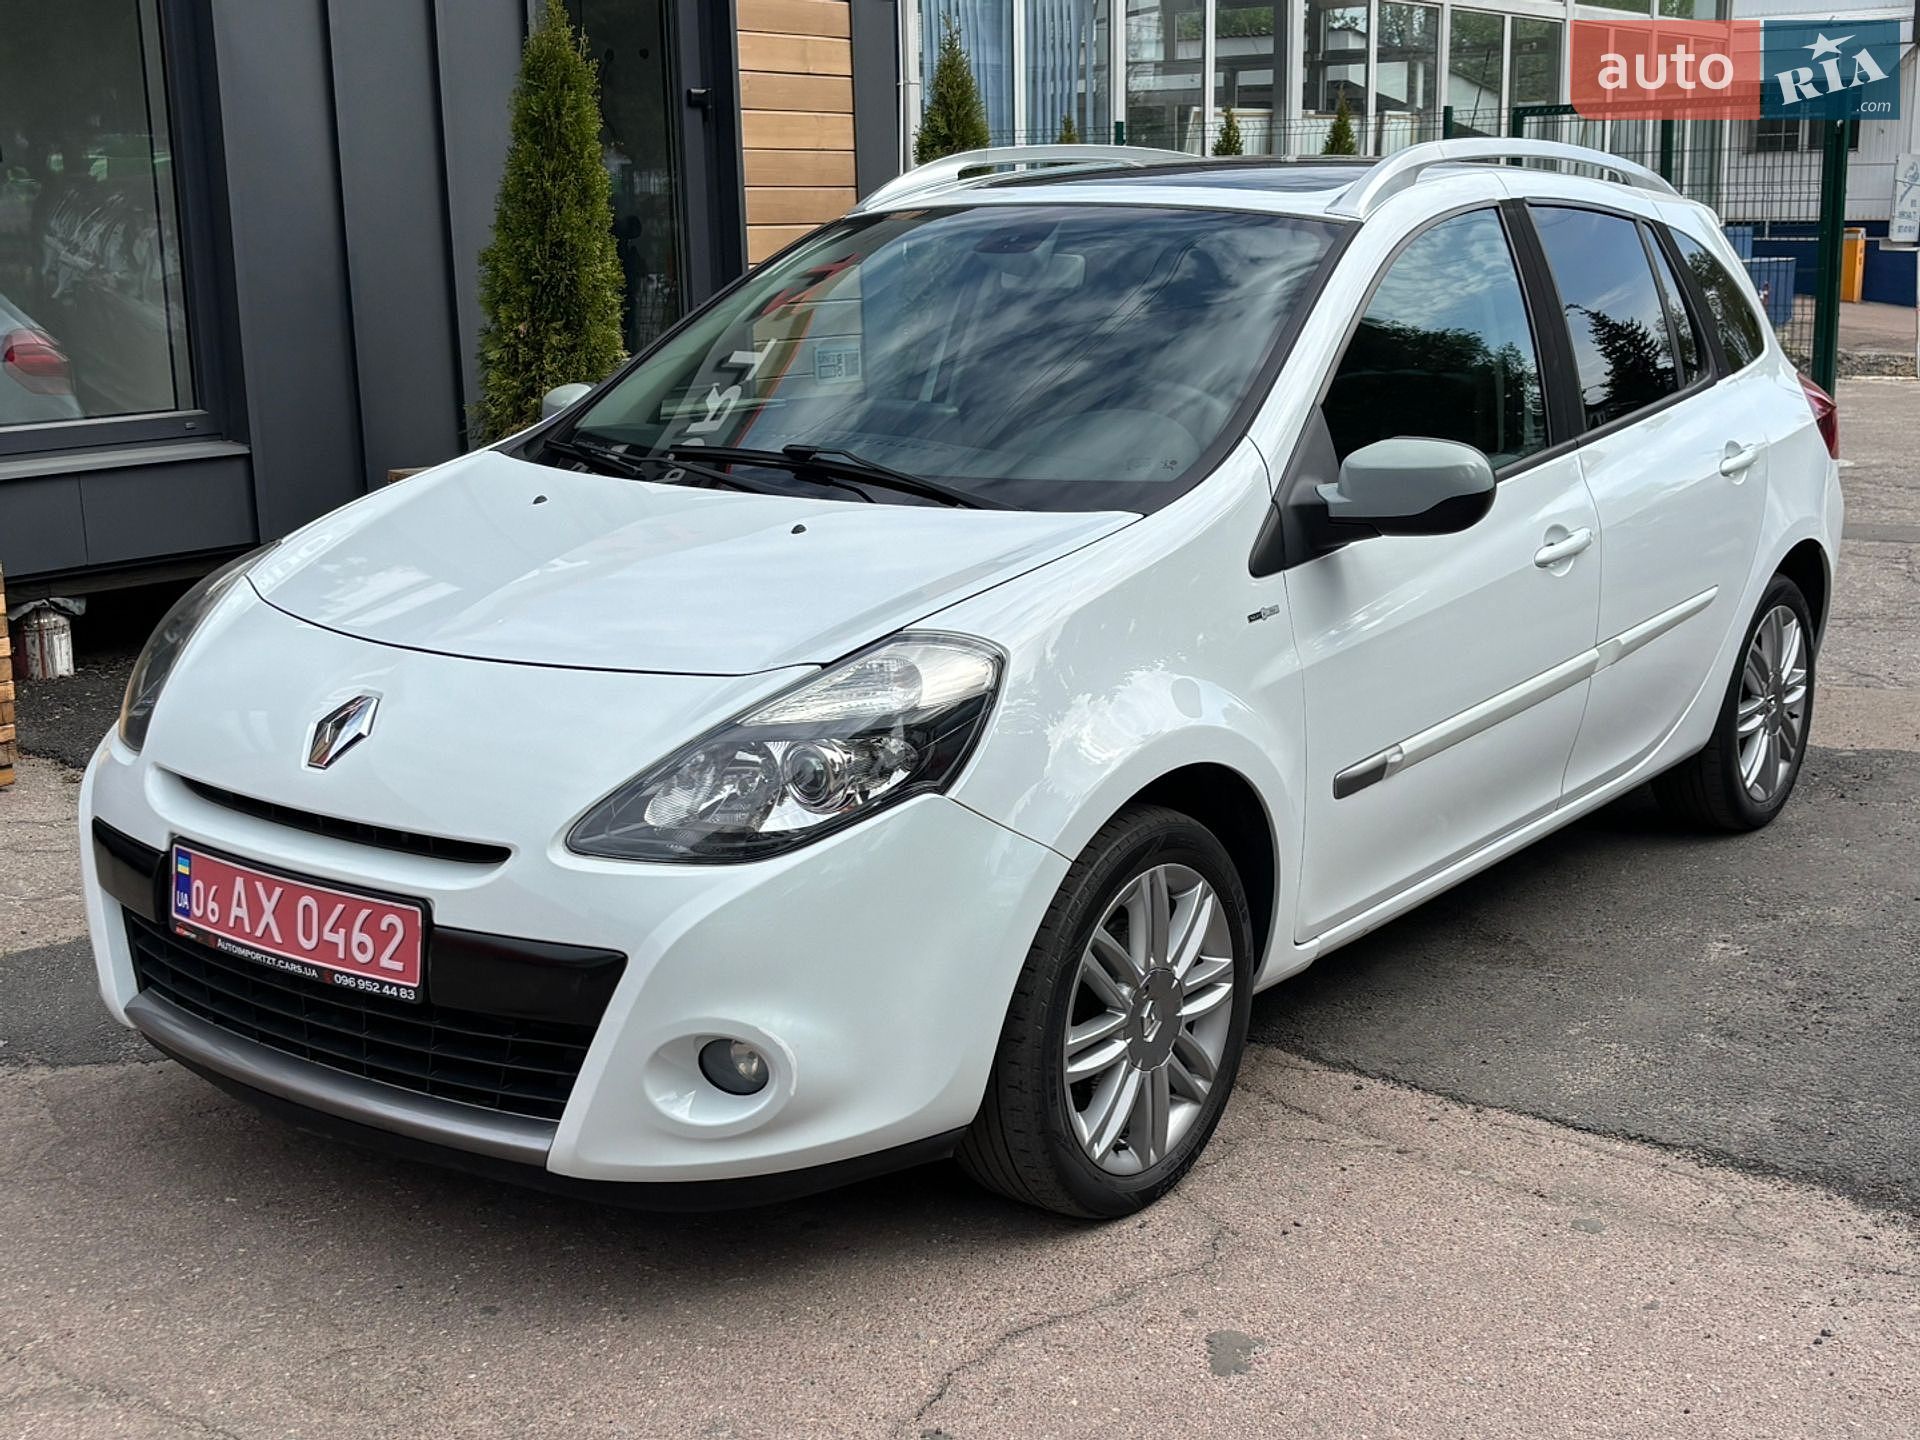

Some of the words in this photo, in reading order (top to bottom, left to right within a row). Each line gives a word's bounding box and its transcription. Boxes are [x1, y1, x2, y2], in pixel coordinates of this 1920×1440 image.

[177, 890, 190, 910] UA
[193, 879, 219, 923] 06
[229, 876, 283, 944] AX
[297, 895, 405, 972] 0462
[334, 973, 356, 987] 096
[357, 979, 380, 993] 952
[382, 984, 398, 996] 44
[399, 987, 415, 1000] 83
